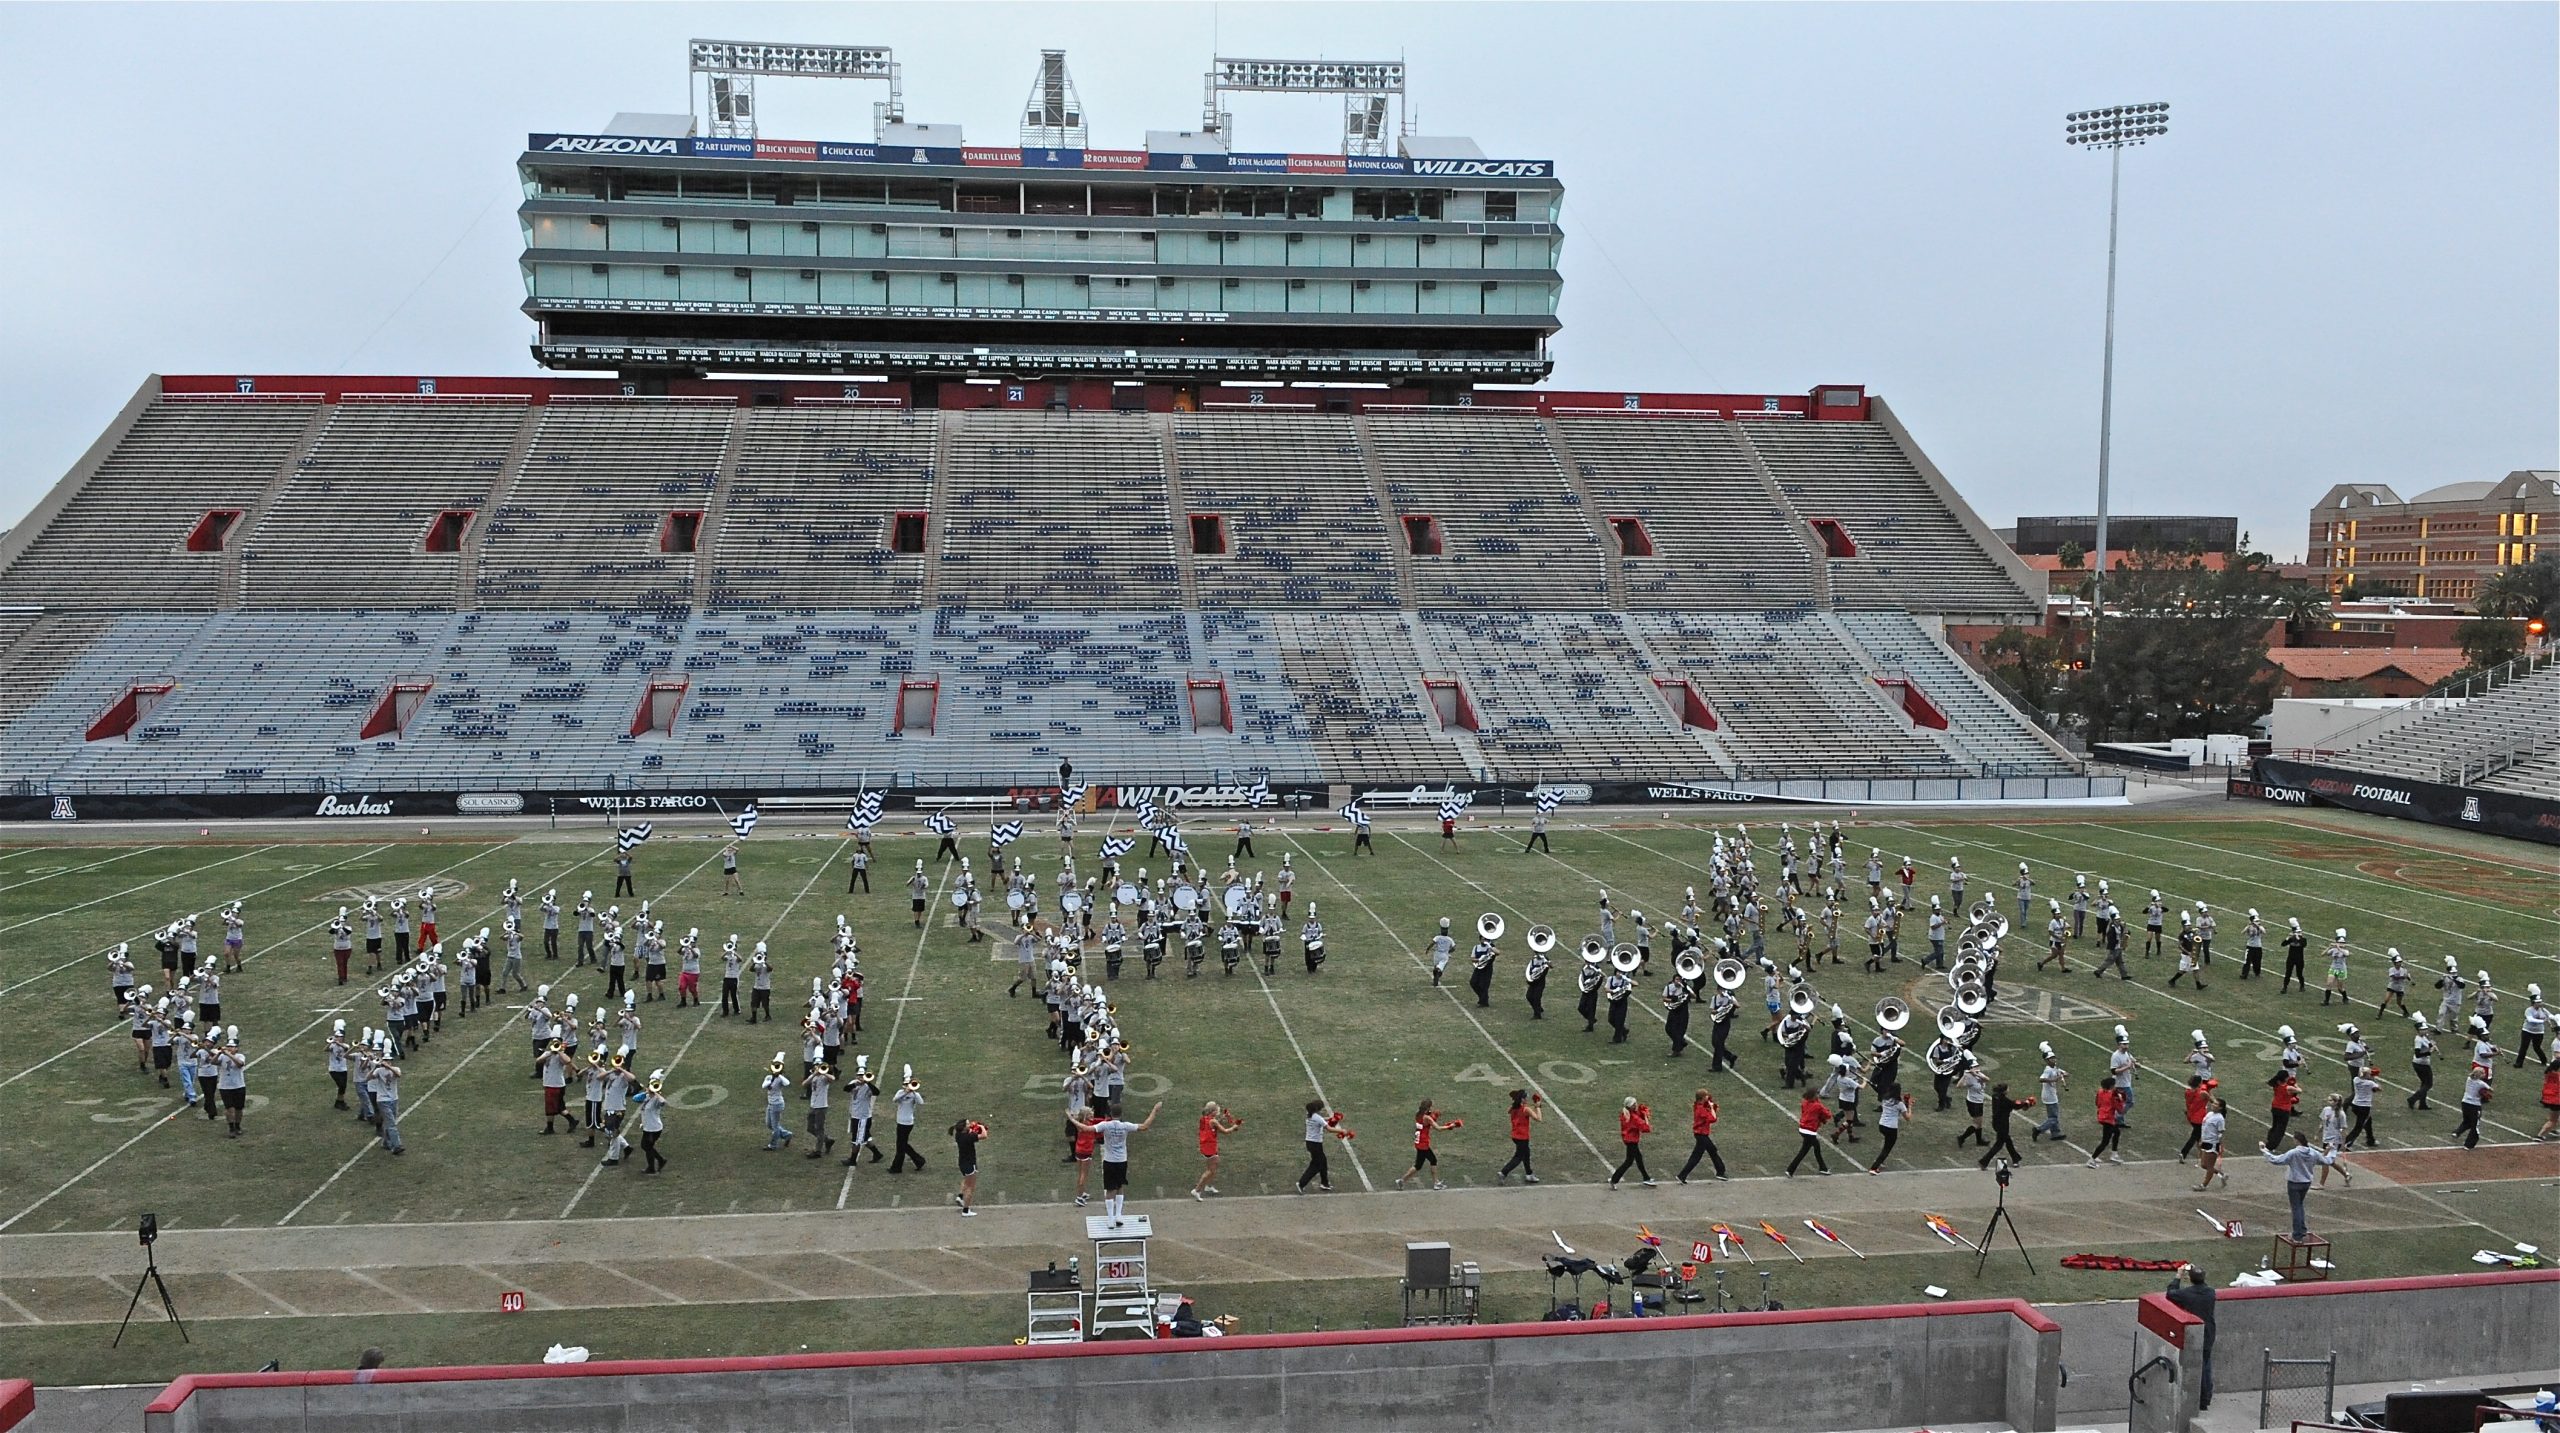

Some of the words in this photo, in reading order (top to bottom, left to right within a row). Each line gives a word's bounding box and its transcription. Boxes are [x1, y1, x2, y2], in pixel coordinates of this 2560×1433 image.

[544, 138, 678, 154] ARIZONA
[696, 142, 704, 150] 22
[705, 143, 719, 151] ART
[720, 143, 751, 152] LUPPINO
[766, 144, 787, 153] RICKY
[788, 145, 816, 154] HUNLEY
[828, 146, 853, 156] CHUCK
[854, 147, 875, 157] CECIL
[962, 151, 968, 159] 4
[968, 152, 999, 160] DARRYLL
[1000, 153, 1021, 161] LEWIS
[1083, 154, 1092, 163] 92
[1093, 155, 1108, 163] ROB
[1108, 156, 1142, 164] WALDROP
[1228, 157, 1237, 166] 28
[1237, 158, 1252, 166] STEVE
[1253, 158, 1287, 167] McLAUGHLIN
[1288, 158, 1294, 166] 11
[1294, 159, 1313, 167] CHRIS
[1313, 159, 1346, 168] McALISTER
[1348, 159, 1353, 168] 5
[1353, 161, 1380, 169] ANTOINE
[1381, 161, 1404, 170] CASON
[1412, 160, 1546, 177] WILDCATS
[239, 383, 252, 393] 17
[420, 384, 433, 394] 18
[622, 386, 635, 396] 19
[844, 389, 859, 398] 20
[1009, 390, 1022, 400] 21
[1250, 394, 1264, 404] 22
[1458, 397, 1472, 406] 23
[1625, 400, 1638, 410] 24
[1765, 402, 1778, 412] 25
[1647, 787, 1700, 799] WELLS
[2233, 782, 2264, 797] BEAR
[2265, 786, 2306, 803] DOWN
[2352, 784, 2411, 805] FOOTBALL
[316, 795, 394, 816] Bashas'
[481, 798, 517, 806] CASINOS
[587, 796, 646, 808] WELLS
[649, 795, 706, 807] FARGO
[2228, 1222, 2242, 1238] 30
[1692, 1243, 1708, 1260] 40
[1111, 1261, 1128, 1278] 50
[503, 1293, 522, 1311] 40
